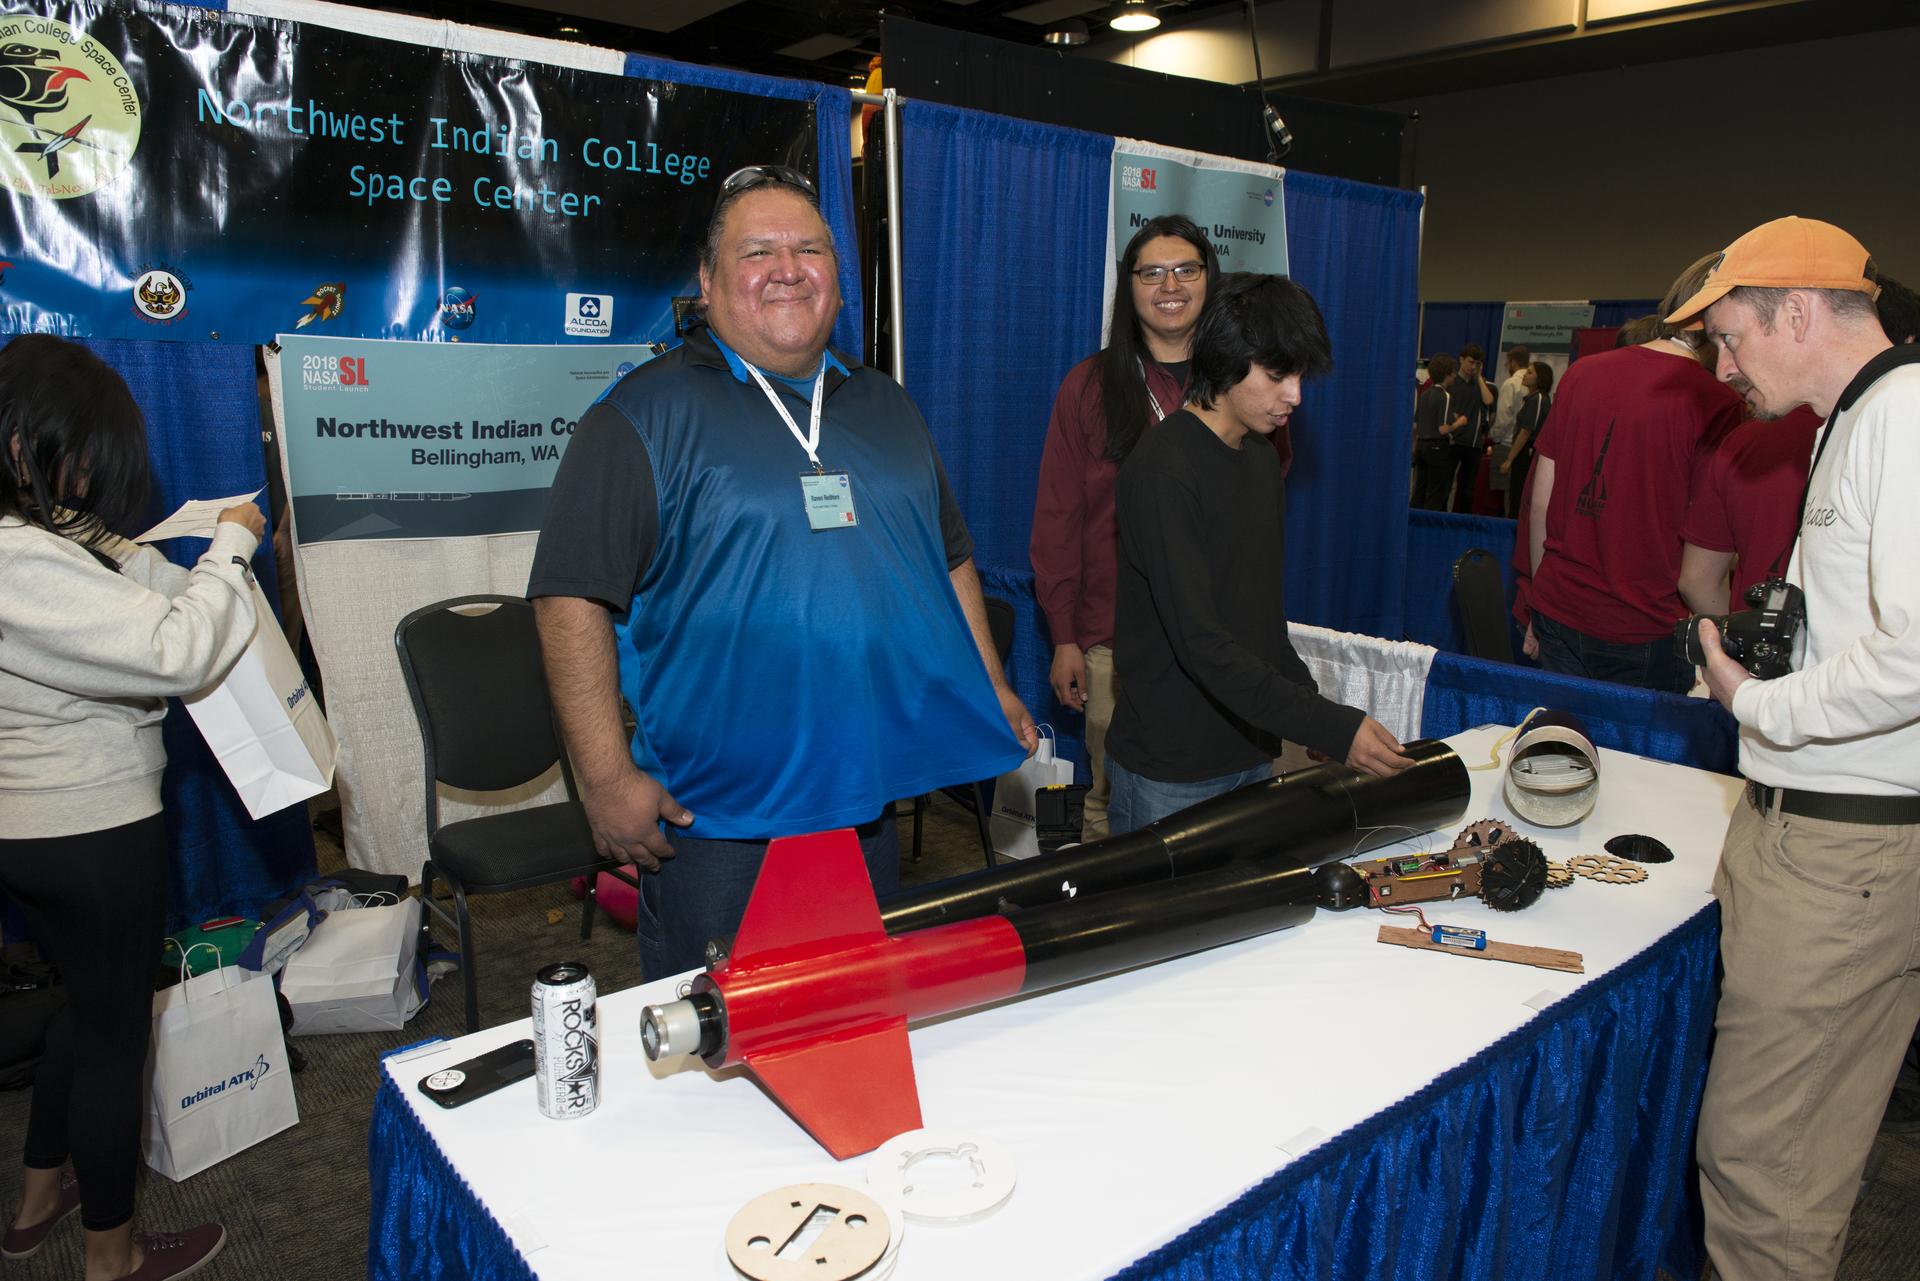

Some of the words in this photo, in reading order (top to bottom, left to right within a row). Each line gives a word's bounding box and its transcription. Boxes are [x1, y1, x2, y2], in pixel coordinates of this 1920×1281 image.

[24, 19, 78, 45] College
[80, 40, 117, 76] Space
[113, 76, 137, 117] Center
[198, 88, 404, 145] Northwest
[430, 117, 558, 162] Indian
[583, 137, 710, 186] College
[1122, 166, 1141, 177] 2018
[350, 165, 451, 207] Space
[473, 177, 600, 217] Center
[1214, 224, 1266, 245] University
[440, 303, 474, 315] NASA
[566, 326, 609, 334] FOUNDATION
[570, 317, 607, 327] ALCOA
[303, 355, 337, 370] 2018
[339, 356, 369, 386] SL
[303, 370, 340, 385] NASA
[316, 417, 463, 440] Northwest
[472, 419, 543, 440] Indian
[411, 448, 526, 469] Bellingham,
[531, 445, 559, 461] WA
[181, 1079, 226, 1109] Orbital
[228, 1068, 255, 1089] ATK
